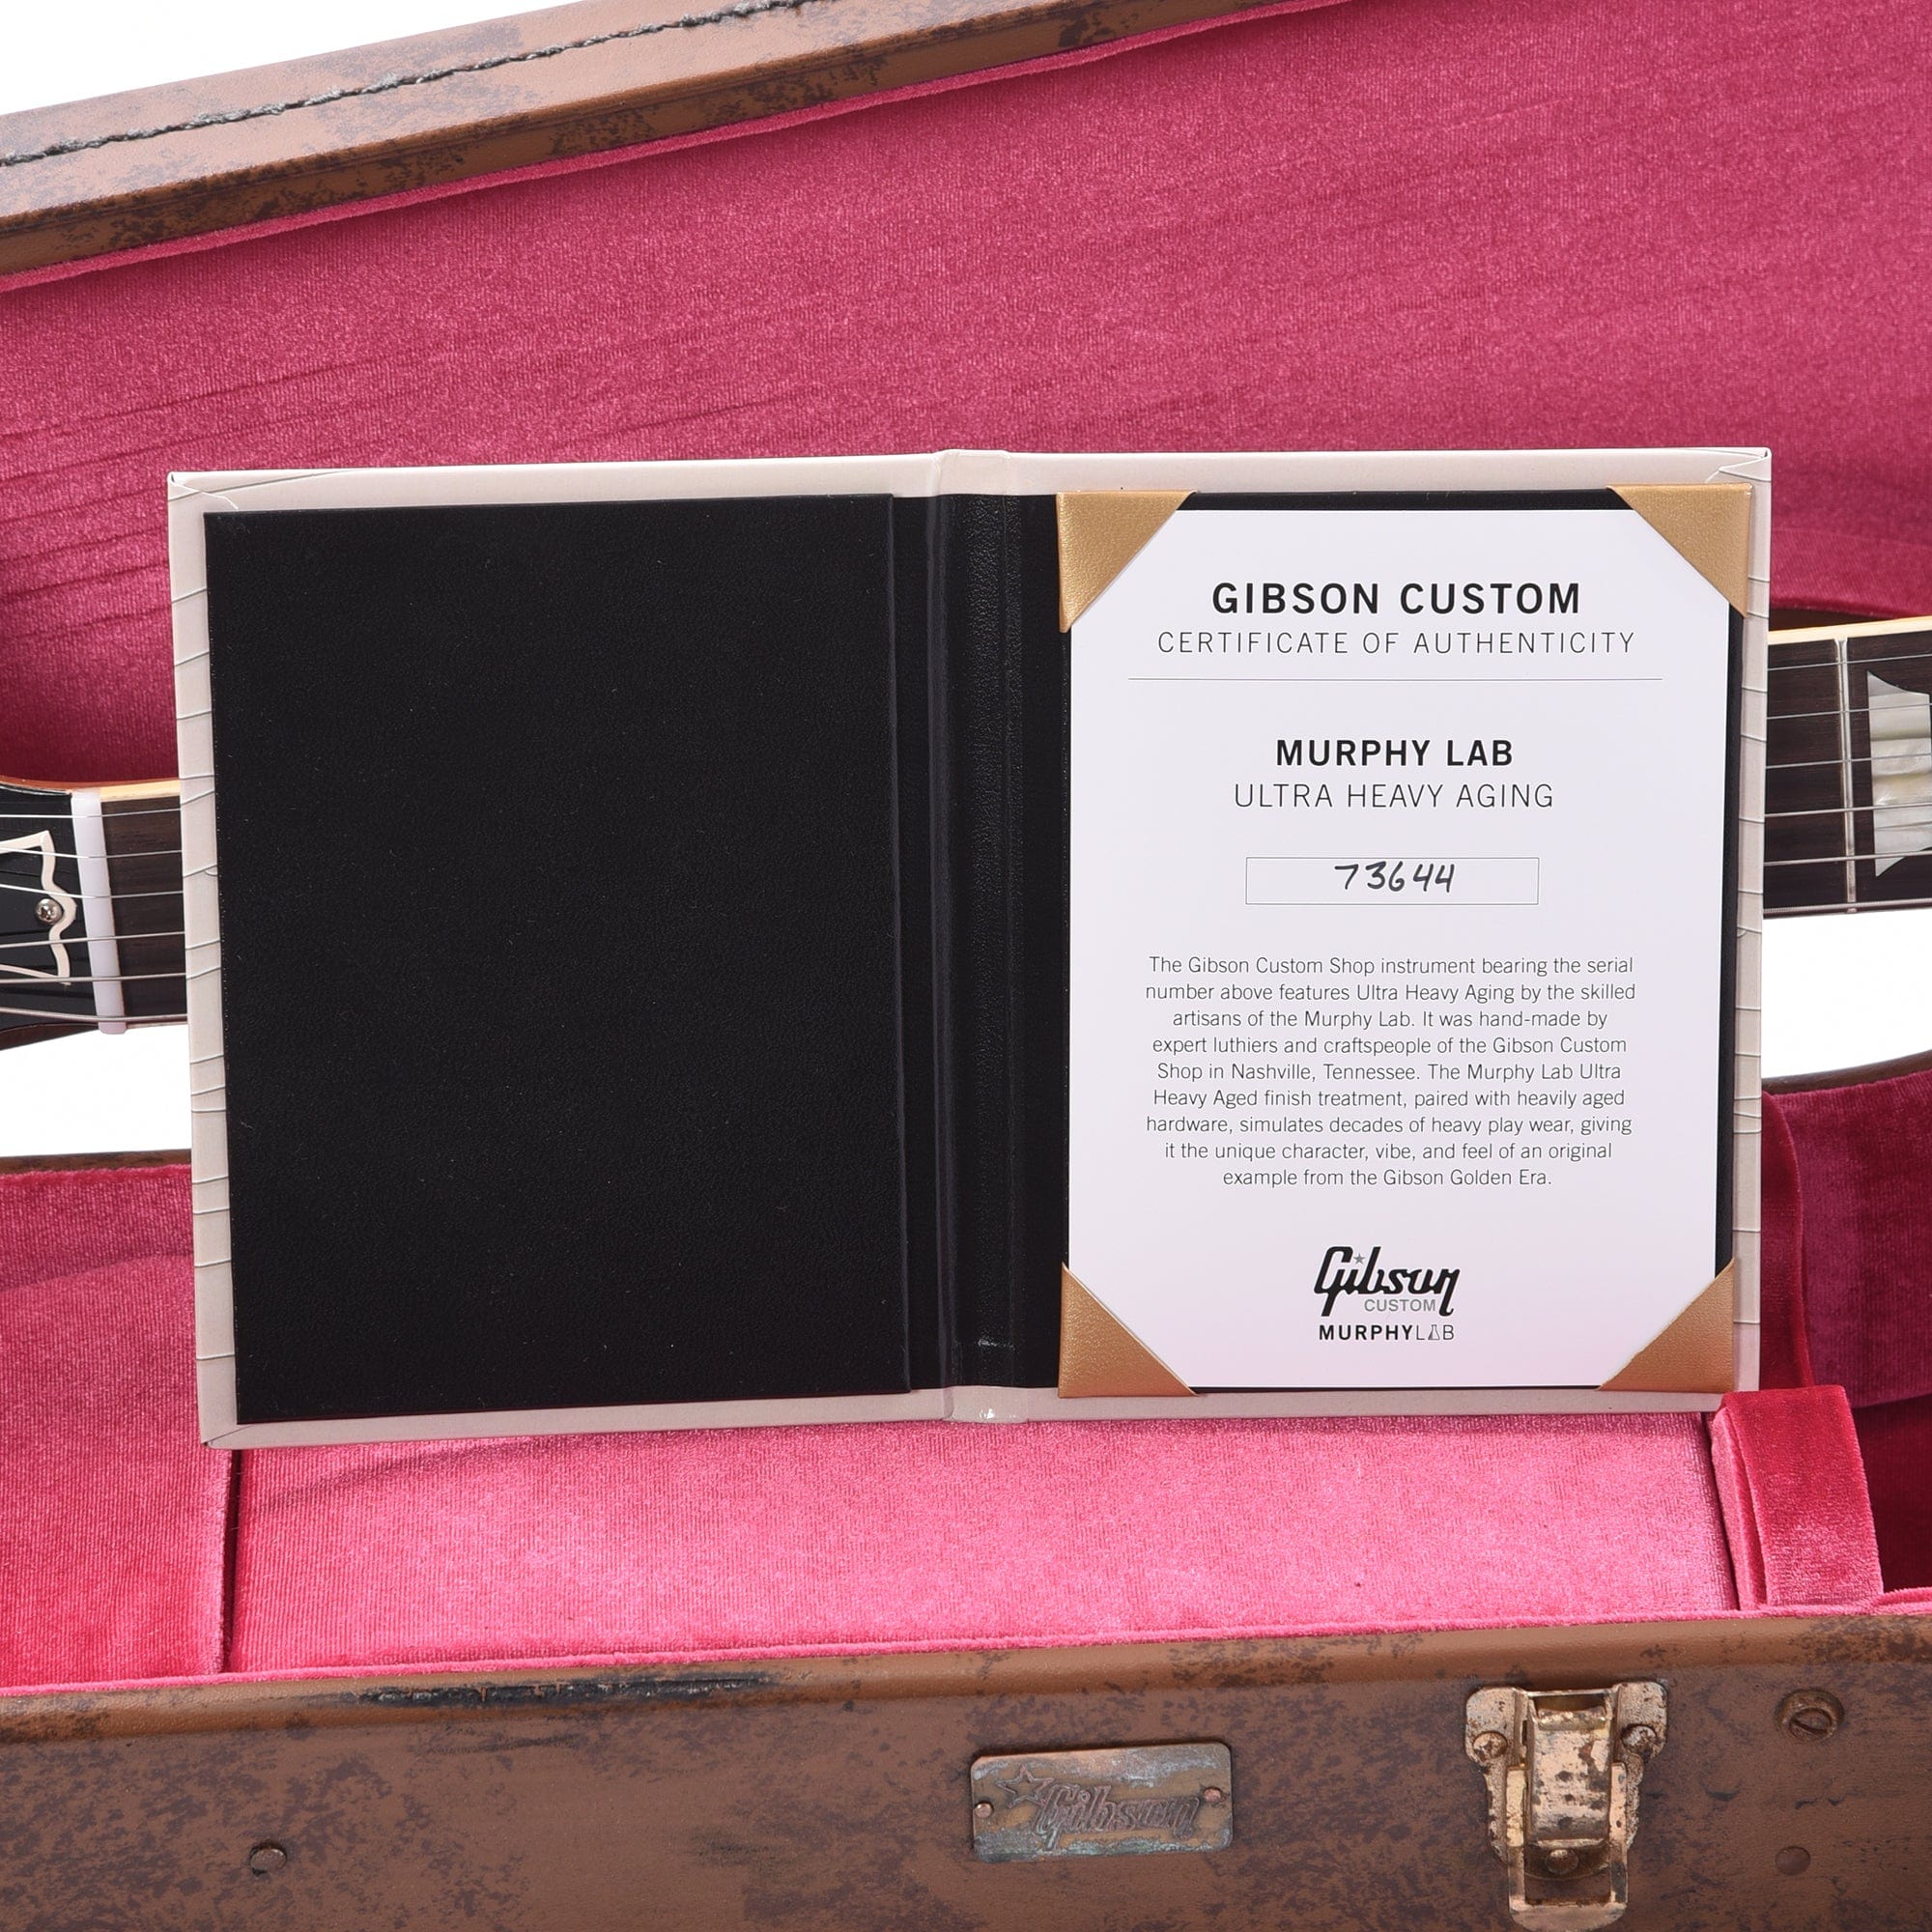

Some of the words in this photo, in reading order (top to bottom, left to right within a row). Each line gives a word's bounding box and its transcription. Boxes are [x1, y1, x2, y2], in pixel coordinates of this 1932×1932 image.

[1211, 582, 1378, 615] GIBSON
[1400, 582, 1579, 615] CUSTOM
[1157, 631, 1349, 654] CERTIFICATE
[1362, 632, 1400, 654] OF
[1412, 631, 1634, 655] AUTHENTICITY
[1276, 739, 1432, 767] MURPHY
[1446, 739, 1513, 767] LAB
[1235, 782, 1333, 809] ULTRA
[1347, 783, 1444, 809] HEAVY
[1455, 782, 1553, 809] AGING
[1333, 860, 1456, 894] 73644
[1149, 955, 1182, 974] The
[1188, 955, 1249, 974] Gibson
[1256, 956, 1323, 975] Custom
[1329, 956, 1376, 978] Shop
[1380, 957, 1477, 975] instrument
[1482, 956, 1548, 978] bearing
[1552, 956, 1581, 974] the
[1587, 956, 1634, 974] serial
[1146, 982, 1215, 1000] number
[1219, 982, 1273, 1001] above
[1278, 982, 1350, 1001] features
[1356, 983, 1399, 1001] Ultra
[1406, 983, 1460, 1005] Heavy
[1463, 983, 1516, 1005] Aging
[1520, 983, 1542, 1005] by
[1546, 983, 1576, 1001] the
[1580, 982, 1636, 1001] skilled
[1173, 1009, 1242, 1027] artisans
[1247, 1009, 1265, 1027] of
[1268, 1009, 1298, 1027] the
[1304, 1009, 1373, 1031] Murphy
[1378, 1010, 1415, 1028] Lab.
[1423, 1010, 1435, 1028] It
[1438, 1013, 1473, 1028] was
[1479, 1009, 1581, 1028] hand-made
[1587, 1009, 1608, 1031] by
[1151, 1037, 1208, 1057] expert
[1213, 1036, 1279, 1054] luthiers
[1283, 1037, 1318, 1054] and
[1323, 1037, 1432, 1058] craftspeople
[1436, 1037, 1455, 1054] of
[1459, 1037, 1487, 1054] the
[1492, 1035, 1554, 1054] Gibson
[1559, 1036, 1627, 1054] Custom
[1157, 1062, 1204, 1083] Shop
[1208, 1063, 1224, 1079] in
[1232, 1063, 1316, 1083] Nashville,
[1322, 1063, 1420, 1081] Tennessee.
[1427, 1063, 1461, 1081] The
[1467, 1063, 1535, 1084] Murphy
[1541, 1063, 1574, 1080] Lab
[1579, 1063, 1621, 1080] Ultra
[1153, 1089, 1208, 1110] Heavy
[1212, 1089, 1258, 1110] Aged
[1264, 1089, 1312, 1107] finish
[1318, 1090, 1407, 1109] treatment,
[1414, 1090, 1468, 1110] paired
[1474, 1090, 1511, 1107] with
[1517, 1089, 1577, 1110] heavily
[1581, 1089, 1625, 1110] aged
[1146, 1115, 1233, 1135] hardware,
[1239, 1116, 1324, 1133] simulates
[1328, 1116, 1404, 1133] decades
[1408, 1116, 1427, 1133] of
[1432, 1116, 1483, 1137] heavy
[1488, 1116, 1524, 1137] play
[1528, 1119, 1575, 1135] wear,
[1579, 1115, 1633, 1136] giving
[1165, 1142, 1176, 1159] it
[1180, 1142, 1208, 1159] the
[1214, 1142, 1276, 1163] unique
[1281, 1142, 1369, 1162] character,
[1375, 1143, 1416, 1162] vibe,
[1422, 1142, 1456, 1160] and
[1461, 1142, 1492, 1160] feel
[1498, 1142, 1517, 1159] of
[1520, 1146, 1543, 1159] an
[1548, 1142, 1612, 1163] original
[1223, 1168, 1298, 1189] example
[1302, 1168, 1344, 1186] from
[1350, 1169, 1378, 1186] the
[1382, 1168, 1444, 1186] Gibson
[1450, 1168, 1512, 1186] Golden
[1519, 1168, 1552, 1185] Era.
[1314, 1245, 1462, 1318] Gibson
[1363, 1298, 1436, 1313] CUSTOM
[1031, 1781, 1201, 1851] Gibson
